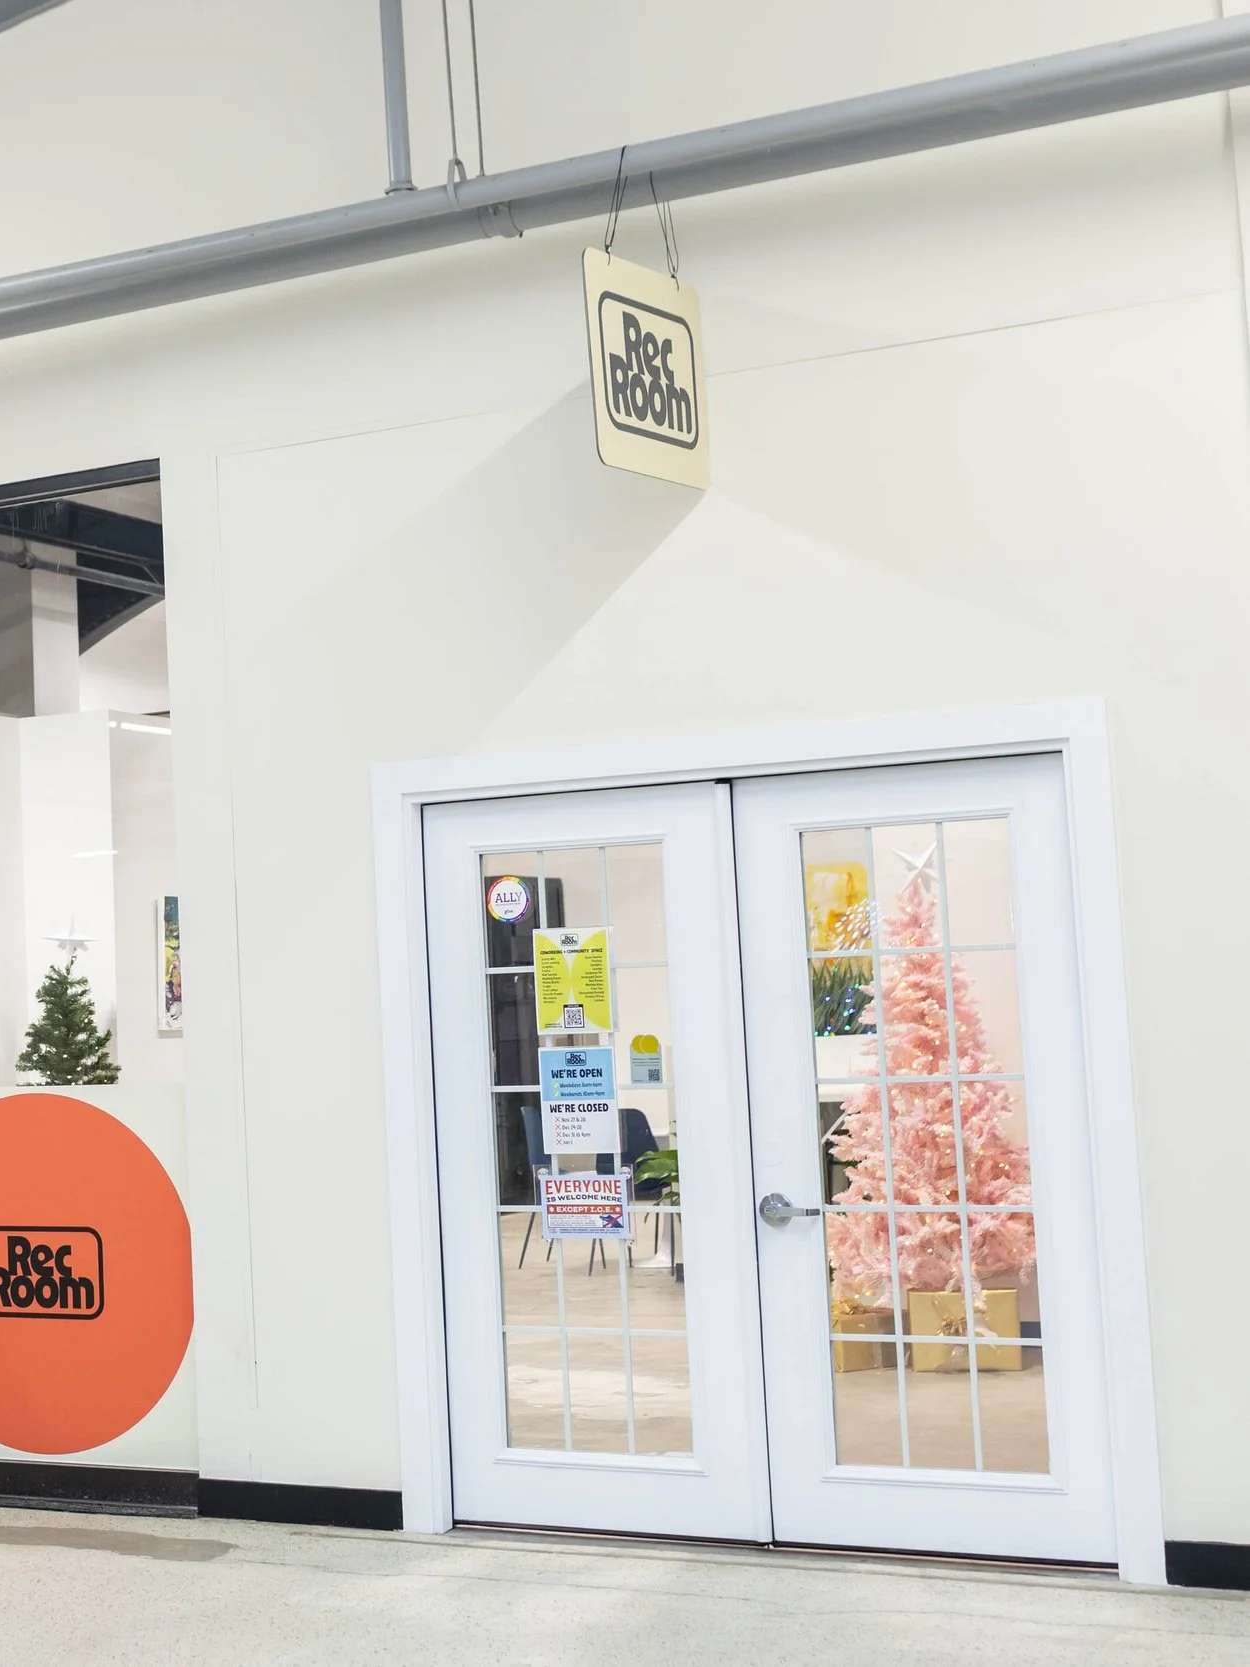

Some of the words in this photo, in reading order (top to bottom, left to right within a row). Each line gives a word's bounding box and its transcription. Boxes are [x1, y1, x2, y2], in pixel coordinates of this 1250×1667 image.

[622, 311, 674, 386] Rec
[609, 352, 692, 434] Room
[495, 892, 522, 903] ALLY
[551, 1069, 577, 1079] WE'RE
[579, 1068, 603, 1078] OPEN
[550, 1104, 576, 1113] WE'RE
[578, 1103, 609, 1113] CLOSED
[546, 1180, 622, 1195] EVERYONE
[600, 1195, 622, 1203] HERE
[7, 1236, 72, 1278] Rec
